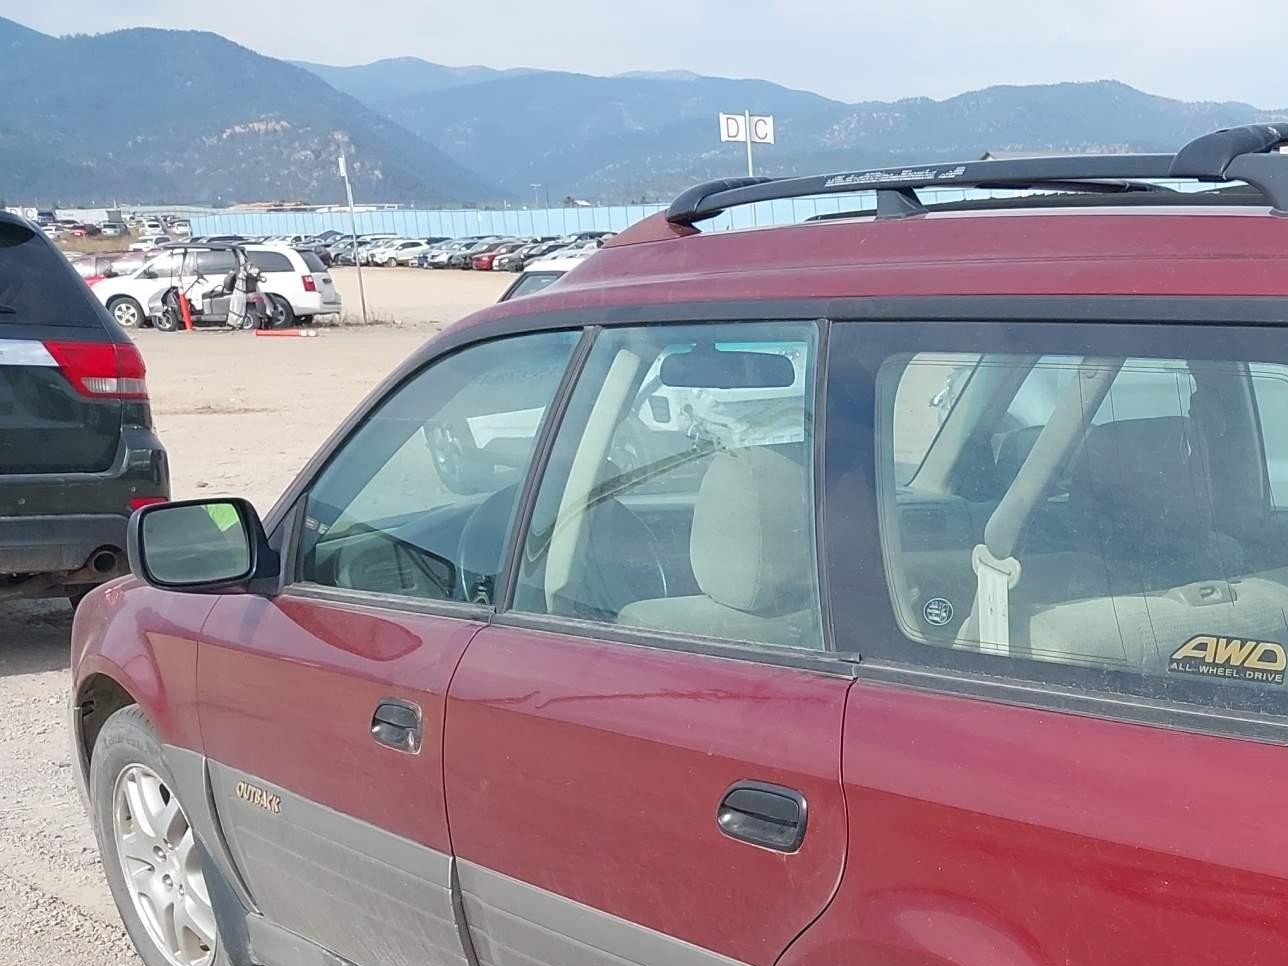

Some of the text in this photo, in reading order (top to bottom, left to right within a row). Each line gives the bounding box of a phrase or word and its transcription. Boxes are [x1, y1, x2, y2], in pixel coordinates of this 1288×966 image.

[726, 117, 768, 140] D C
[1171, 636, 1287, 671] AWD
[1170, 662, 1284, 683] ALL WHEEL DRIVE
[236, 780, 281, 814] OUTBACK
